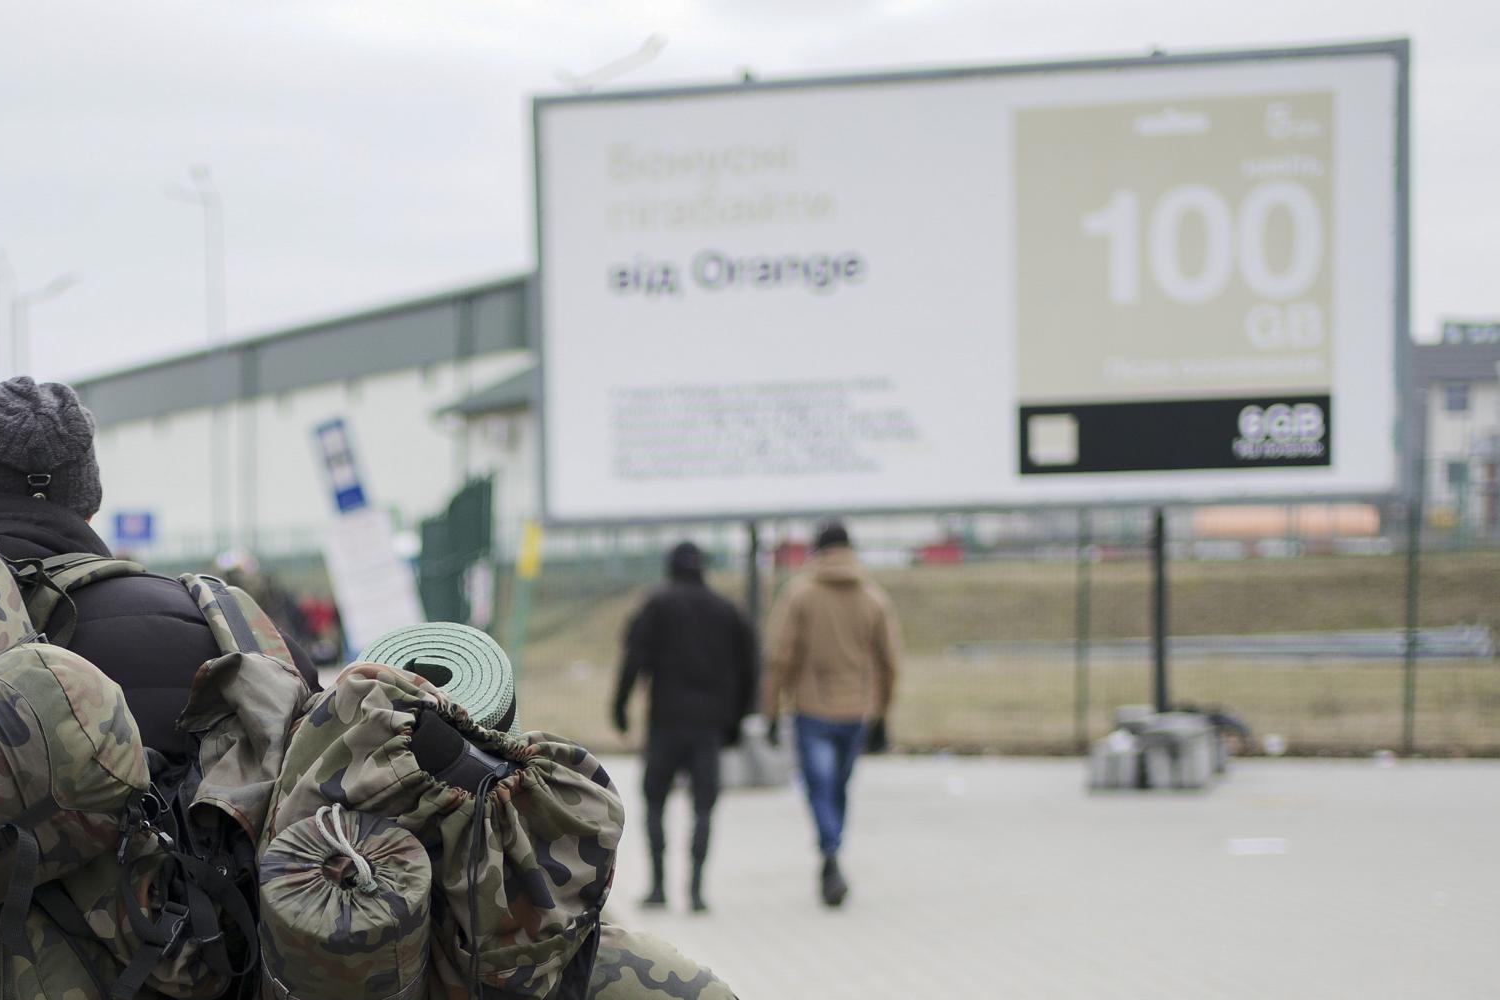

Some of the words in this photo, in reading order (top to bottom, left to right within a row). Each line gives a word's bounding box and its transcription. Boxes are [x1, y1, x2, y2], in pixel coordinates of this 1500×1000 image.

[1082, 183, 1322, 304] 100
[693, 248, 867, 296] Orange
[1246, 302, 1323, 349] GB
